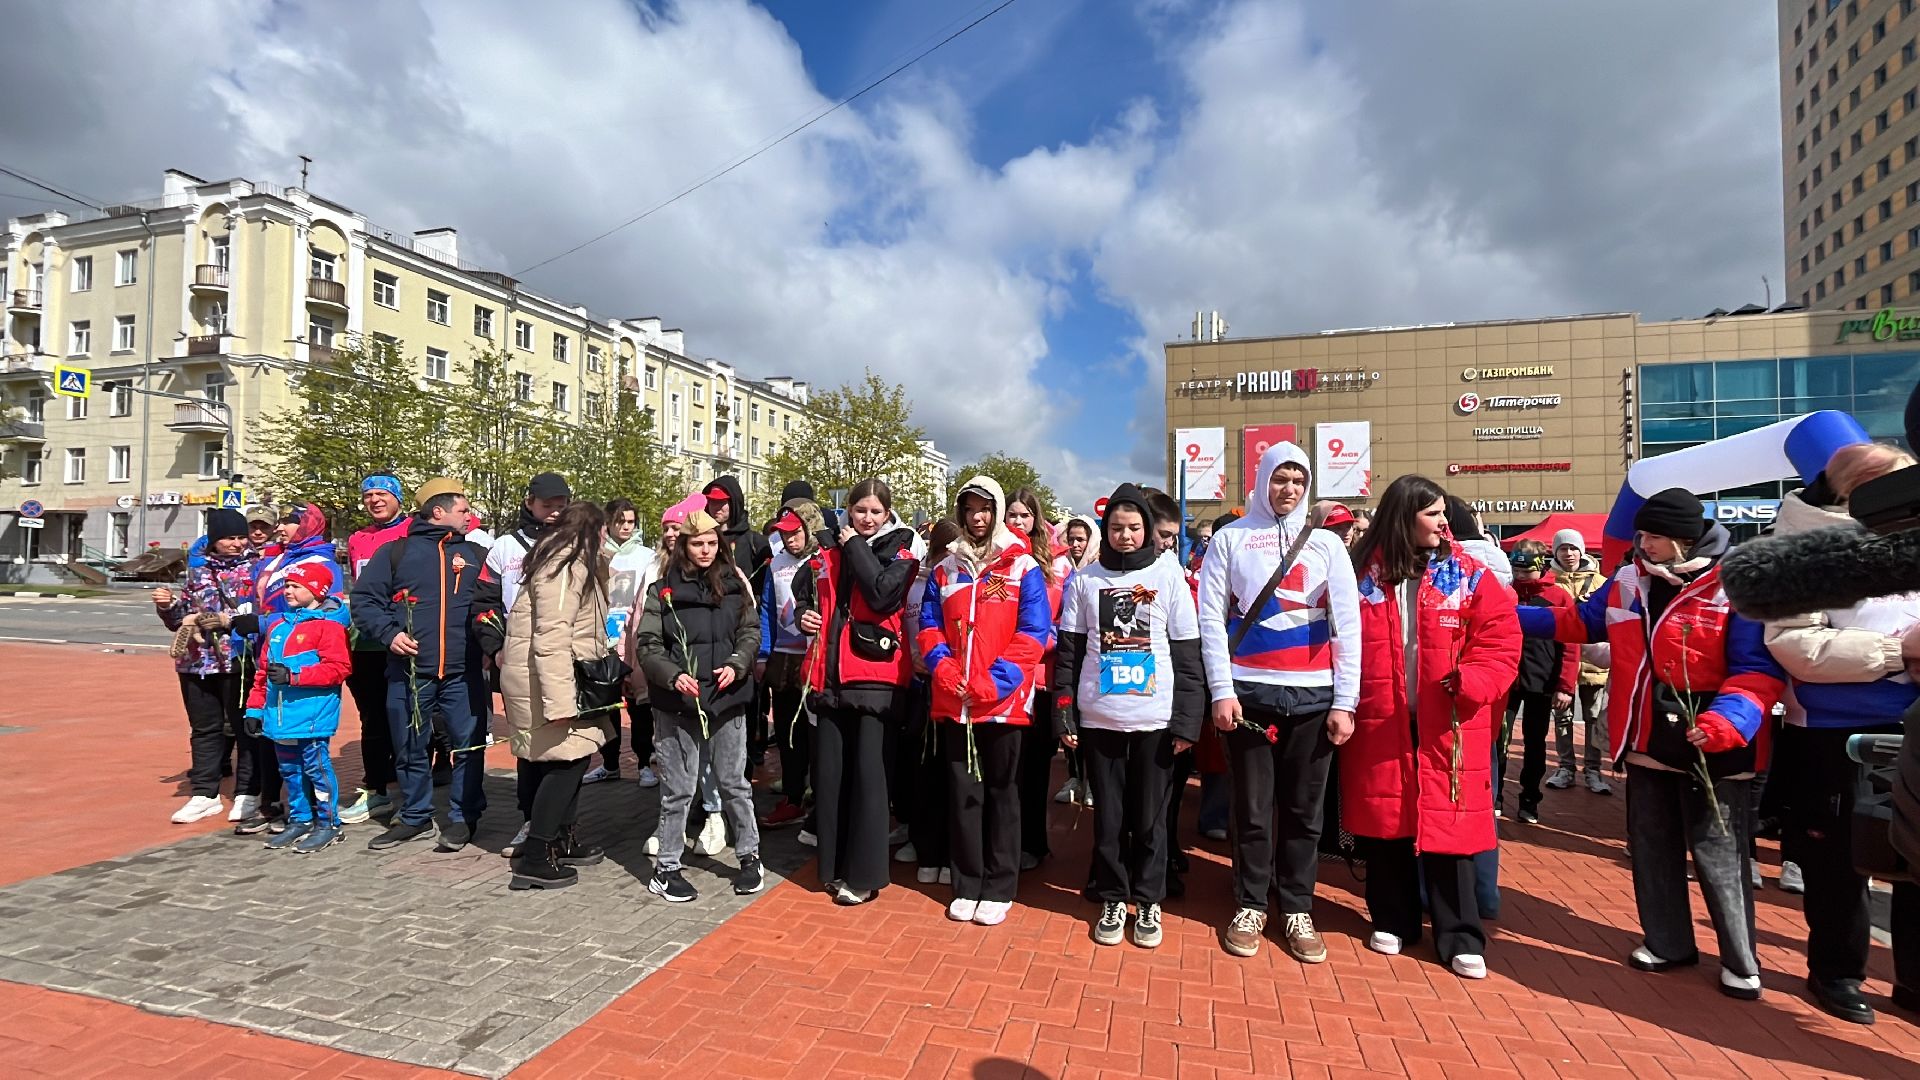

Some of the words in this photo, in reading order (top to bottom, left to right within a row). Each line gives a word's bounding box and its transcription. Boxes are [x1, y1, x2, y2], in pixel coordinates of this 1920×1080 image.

[1482, 365, 1554, 378] ГАЗПРОМБАНК
[1181, 380, 1221, 389] ТЕАТР
[1237, 370, 1292, 392] PRADA
[1334, 371, 1380, 382] КИНО
[1475, 427, 1504, 435] ПИКО
[1507, 426, 1544, 434] ПИЦЦА
[1186, 444, 1200, 462] 9
[1328, 439, 1344, 458] 9
[1466, 499, 1493, 511] АЙТ
[1496, 500, 1527, 511] СТАР
[1531, 500, 1575, 511] ЛАУНЖ
[1718, 505, 1777, 518] DNS
[1111, 665, 1145, 685] 130
